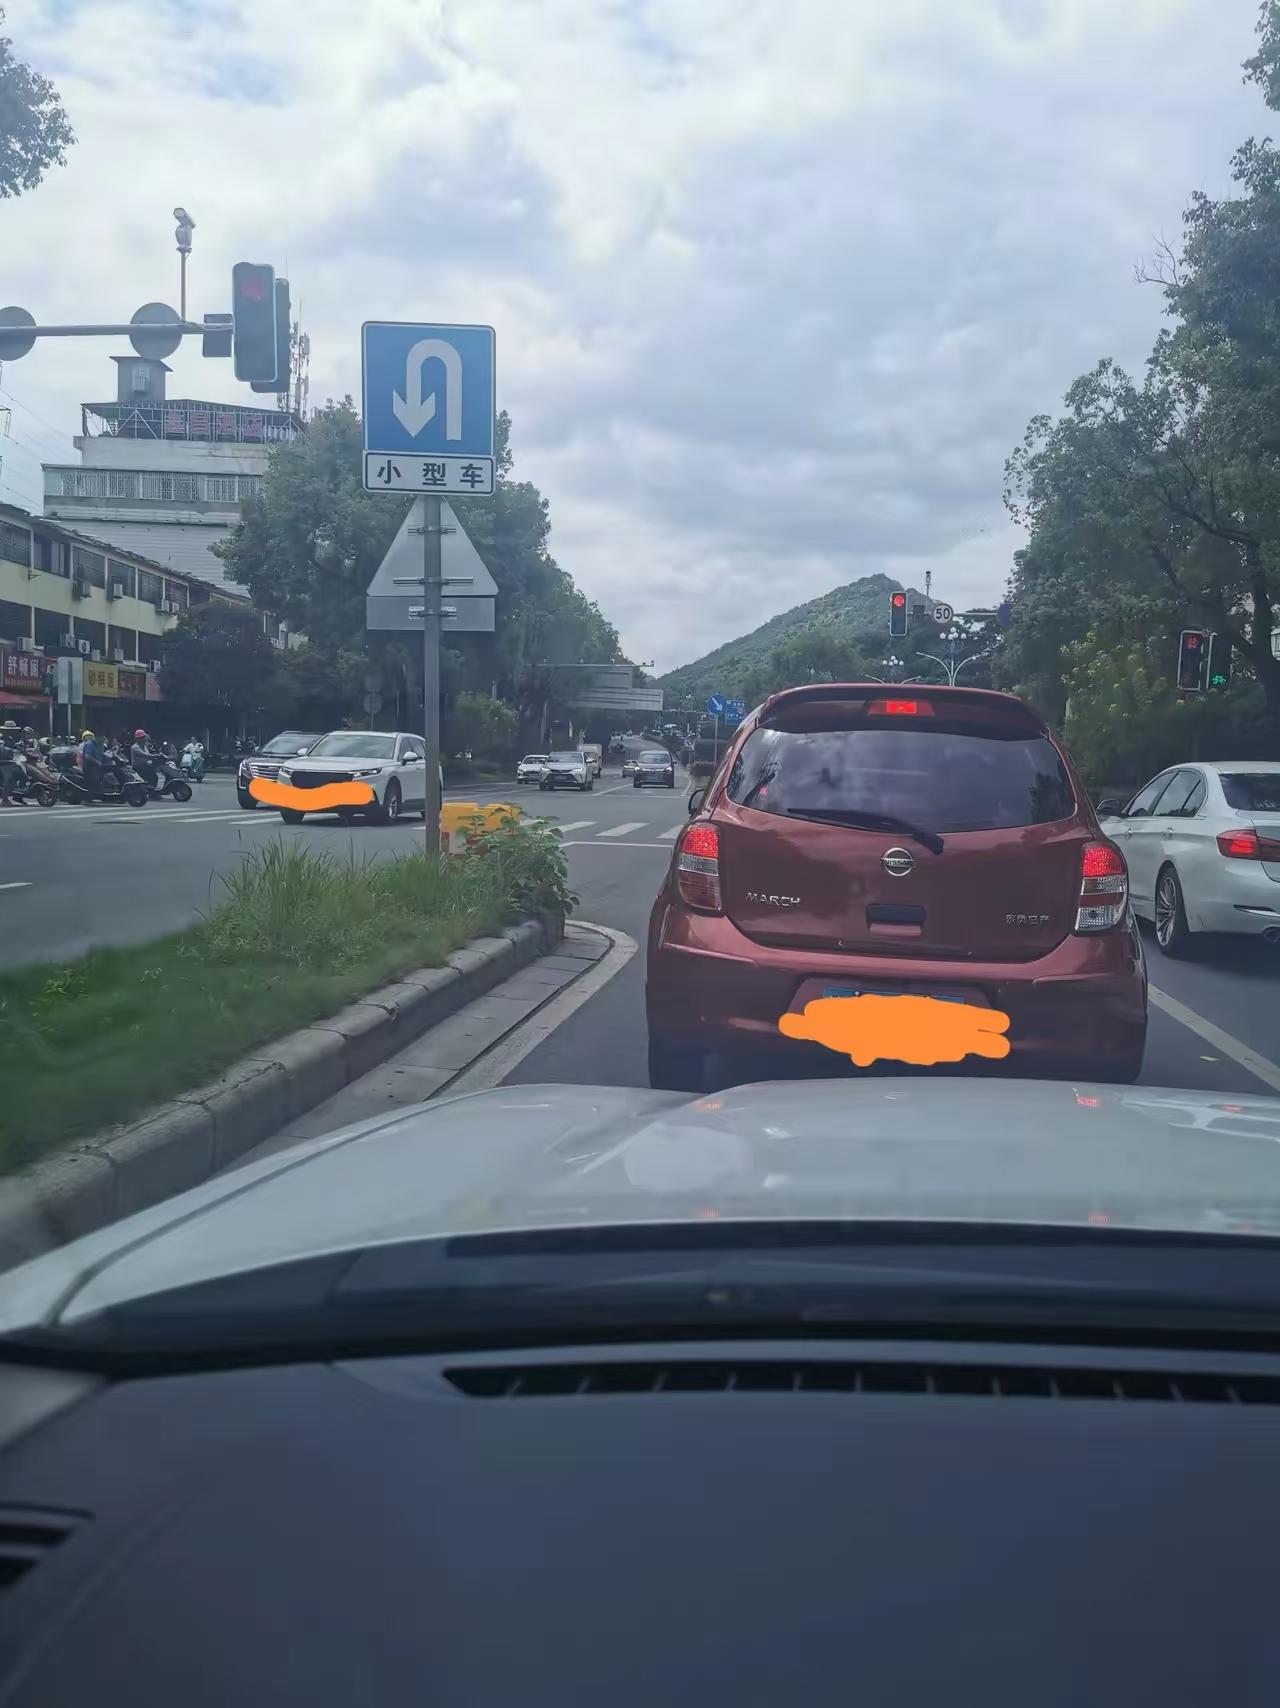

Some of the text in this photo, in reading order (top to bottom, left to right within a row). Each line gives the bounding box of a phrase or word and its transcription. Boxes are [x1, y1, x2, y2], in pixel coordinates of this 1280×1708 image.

[377, 460, 484, 488] 小型车
[936, 608, 950, 619] 50
[745, 892, 801, 906] MARCH
